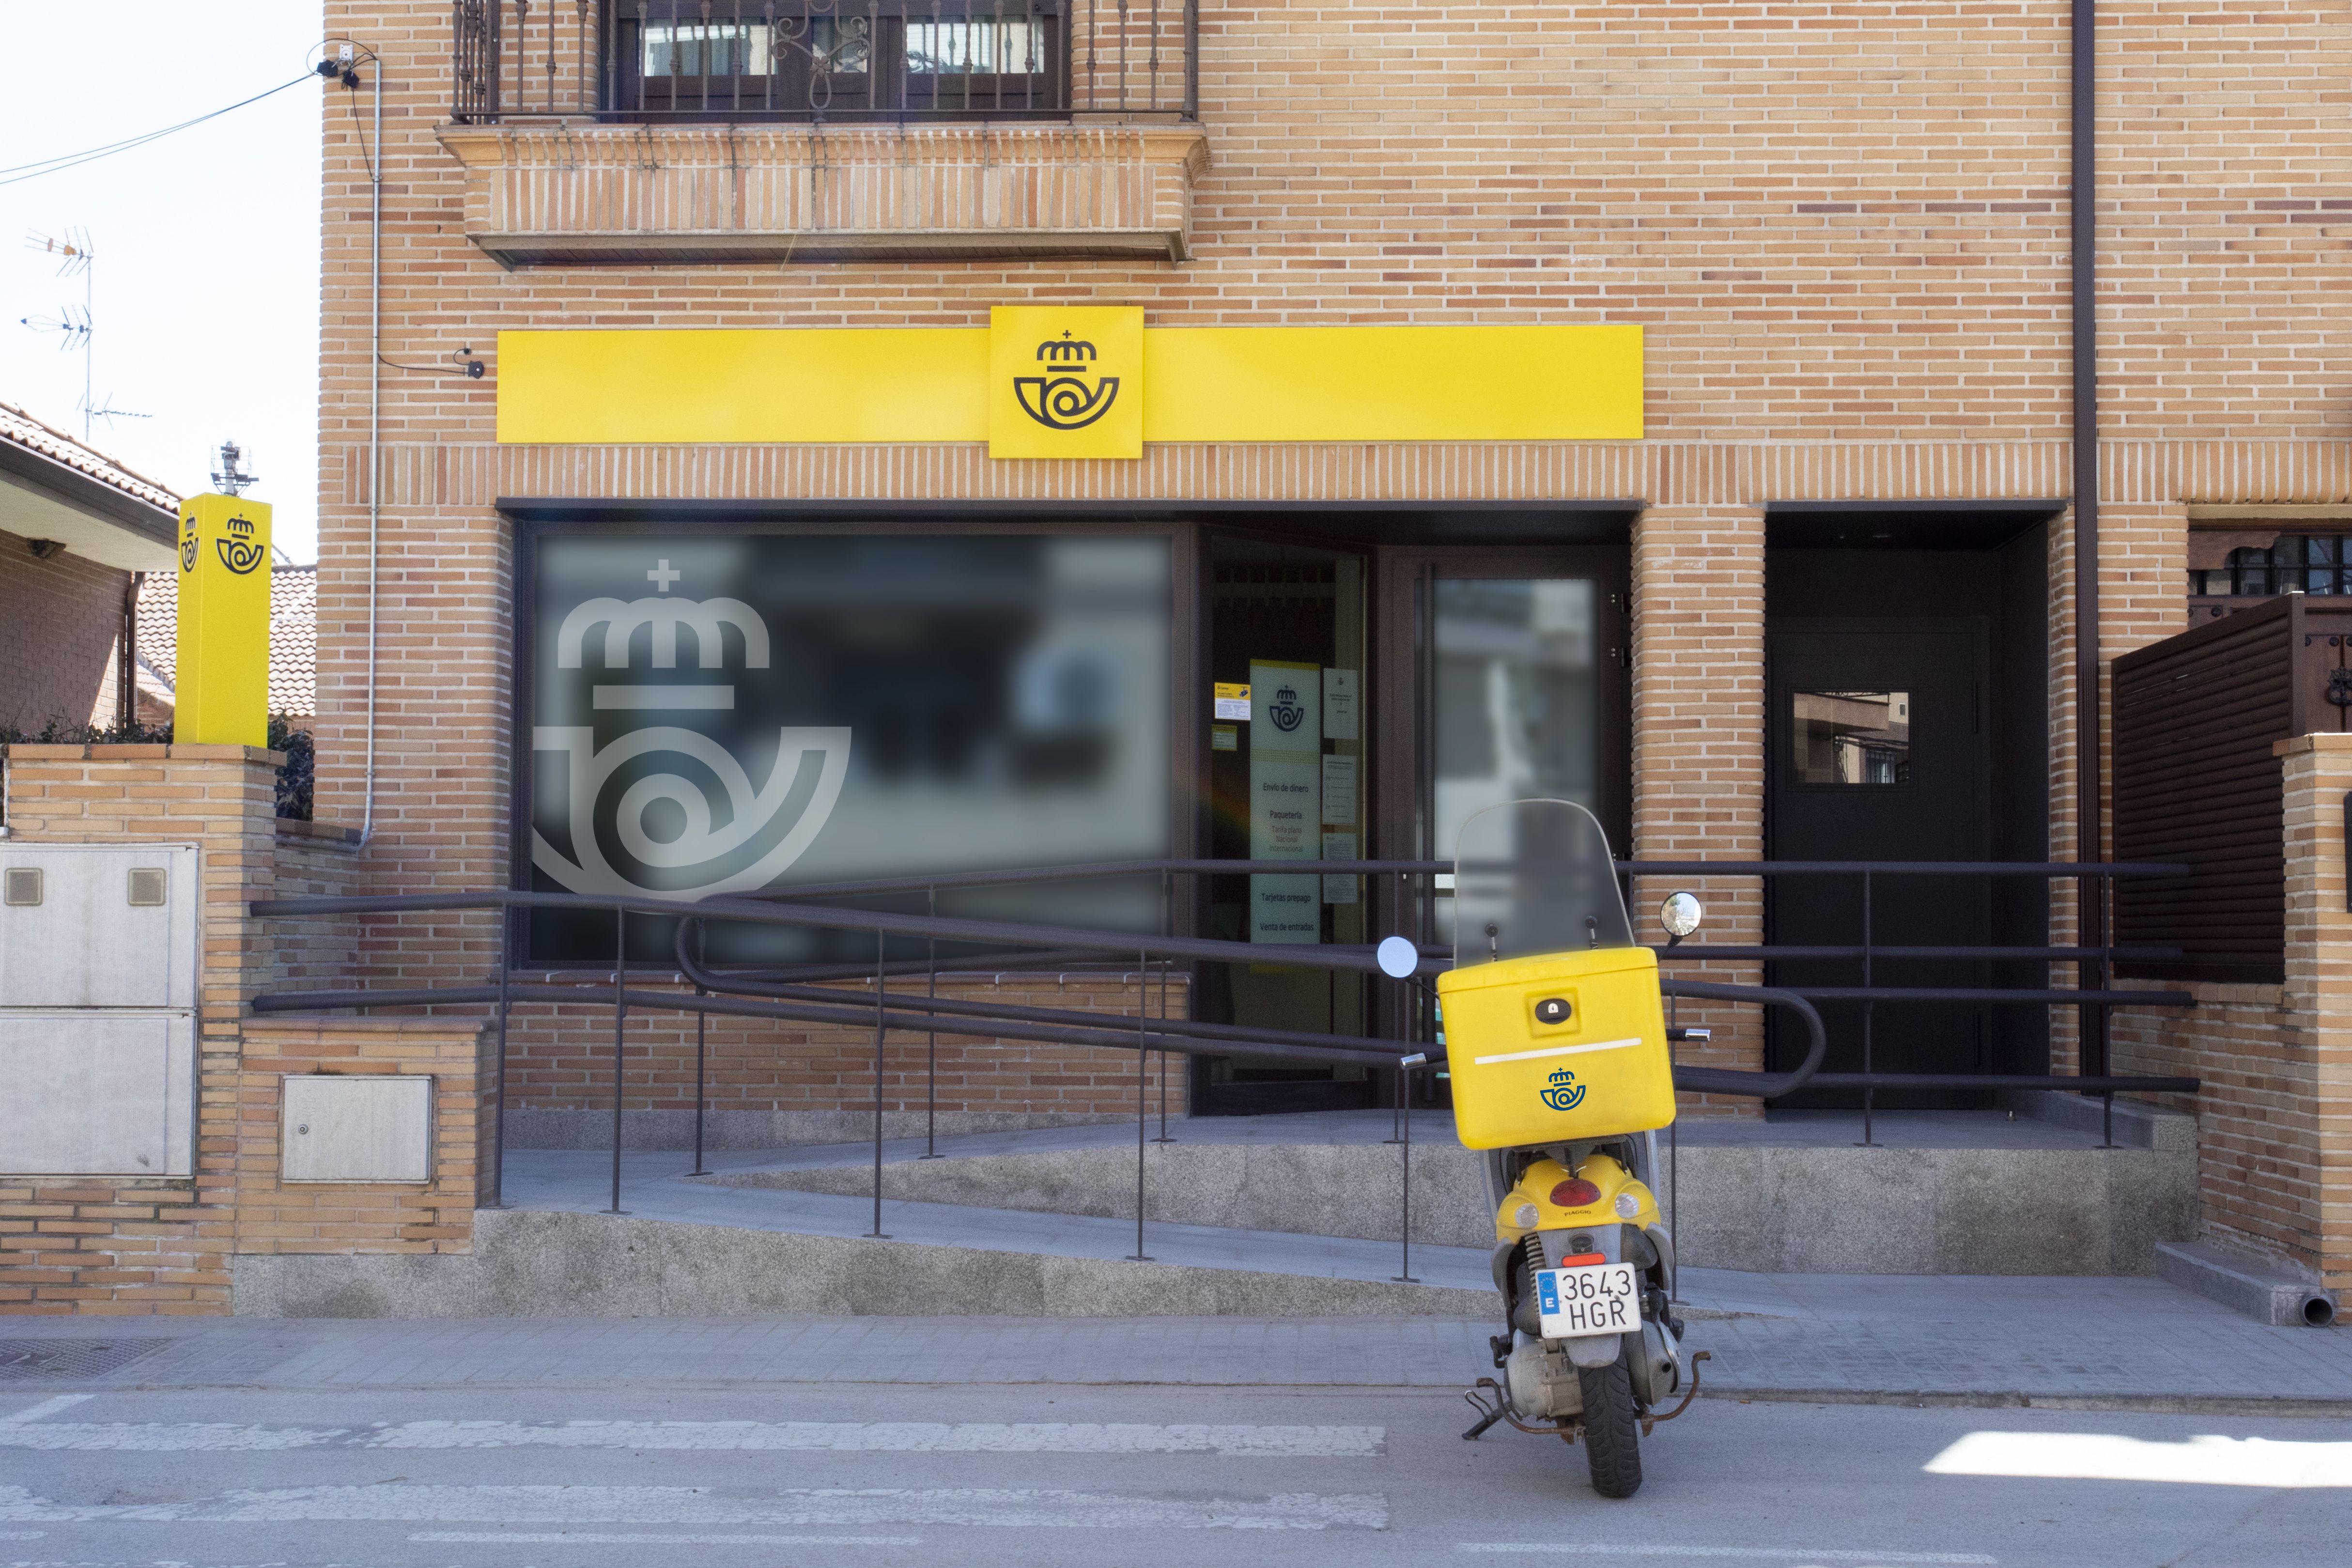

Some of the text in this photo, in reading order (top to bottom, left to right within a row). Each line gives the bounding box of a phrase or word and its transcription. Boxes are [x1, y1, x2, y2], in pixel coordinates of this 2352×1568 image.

[1263, 783, 1309, 792] Envío de dinero
[1270, 810, 1302, 820] Paquetería
[1269, 844, 1303, 853] Internacional
[1261, 893, 1311, 903] Tarjetas prepago
[1260, 922, 1314, 931] Venta de entradas
[1562, 1270, 1631, 1301] 3643
[1545, 1298, 1555, 1308] E
[1569, 1300, 1627, 1330] HGR
